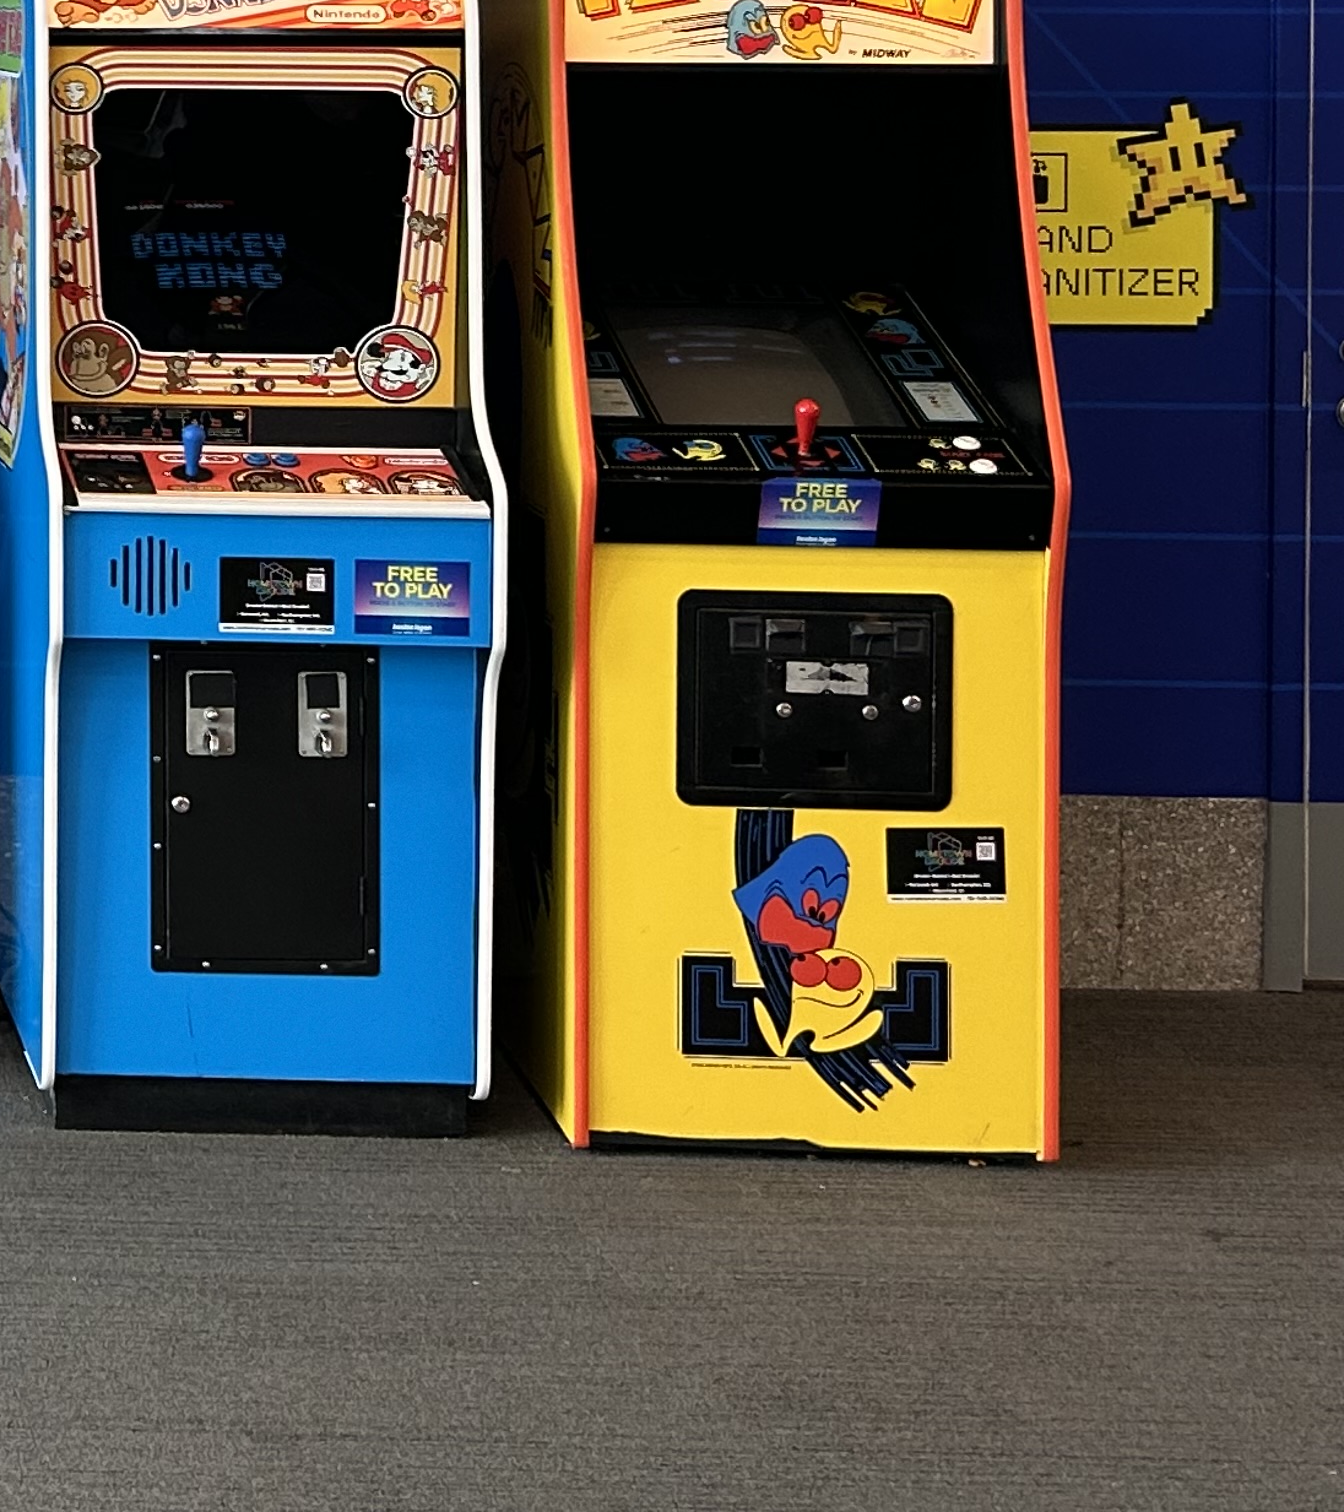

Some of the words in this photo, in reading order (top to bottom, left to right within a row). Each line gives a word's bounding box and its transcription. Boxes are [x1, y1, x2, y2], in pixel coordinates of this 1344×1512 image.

[313, 8, 380, 19] Nintendo
[862, 49, 911, 58] MIDWAY
[131, 232, 287, 259] DONKEY
[1038, 225, 1113, 253] AND
[155, 263, 284, 289] KONG
[1041, 268, 1199, 296] NITIZER
[796, 482, 848, 498] FREE
[779, 497, 807, 512] TO
[812, 499, 862, 514] PLAY
[388, 565, 438, 582] FREE
[372, 582, 400, 598] TO
[405, 583, 452, 599] PLAY
